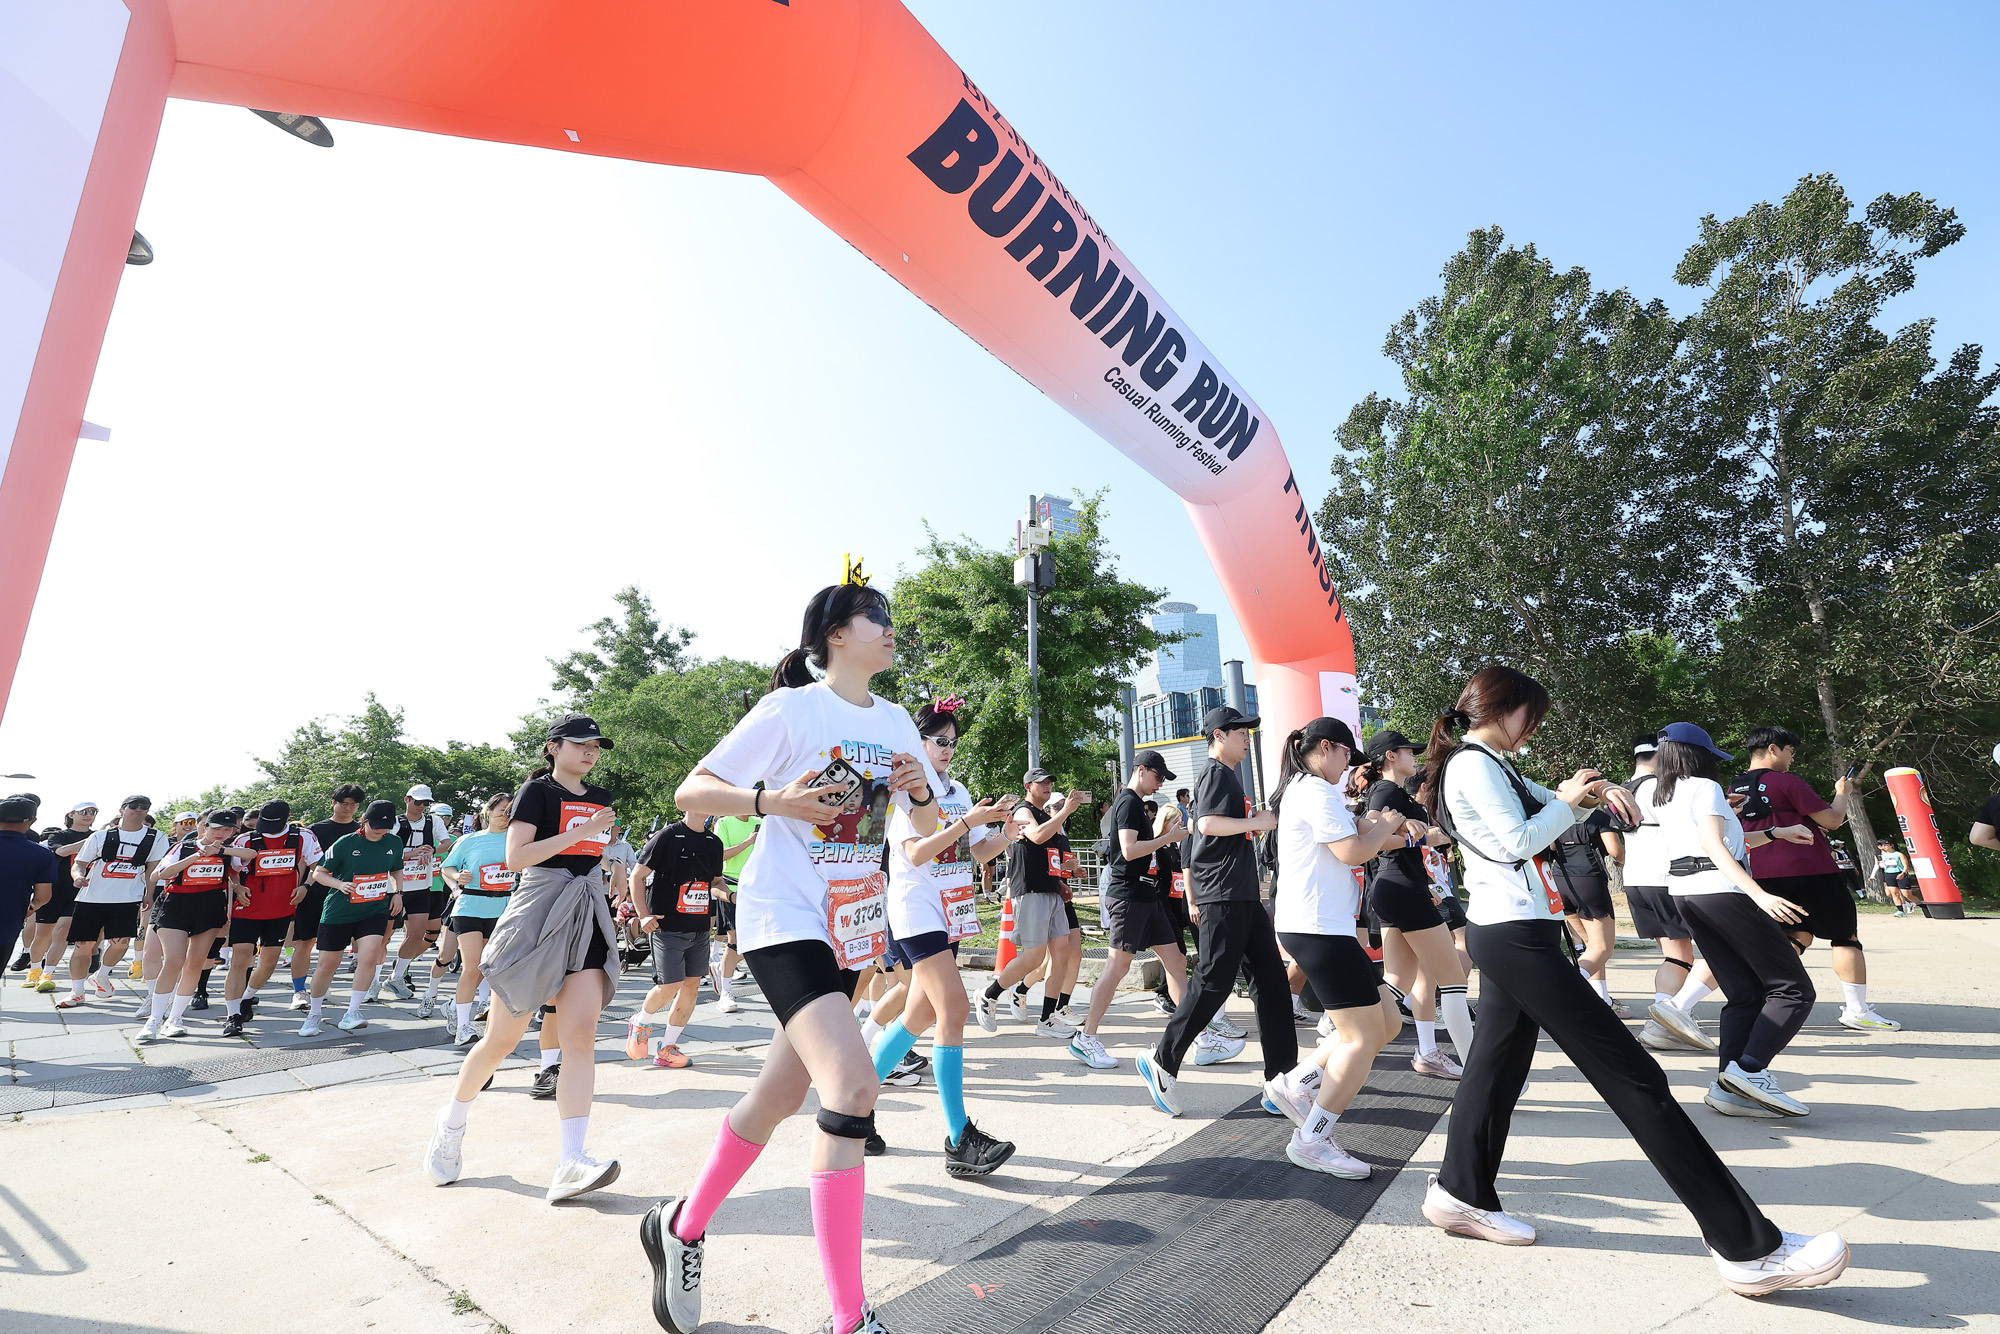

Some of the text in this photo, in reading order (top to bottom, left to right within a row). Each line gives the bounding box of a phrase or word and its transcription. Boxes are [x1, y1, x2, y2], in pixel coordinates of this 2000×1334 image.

[907, 97, 1260, 462] BURNING RUN
[1103, 366, 1228, 476] Casual Running Festival
[841, 739, 893, 767] 여기는
[940, 803, 968, 815] 여기는
[808, 841, 855, 864] 우리가
[495, 871, 515, 879] 4467
[930, 862, 957, 877] 우리가
[367, 882, 387, 890] 4386
[841, 902, 882, 928] W 3706
[948, 903, 974, 917] W 3693
[849, 940, 870, 953] B-338
